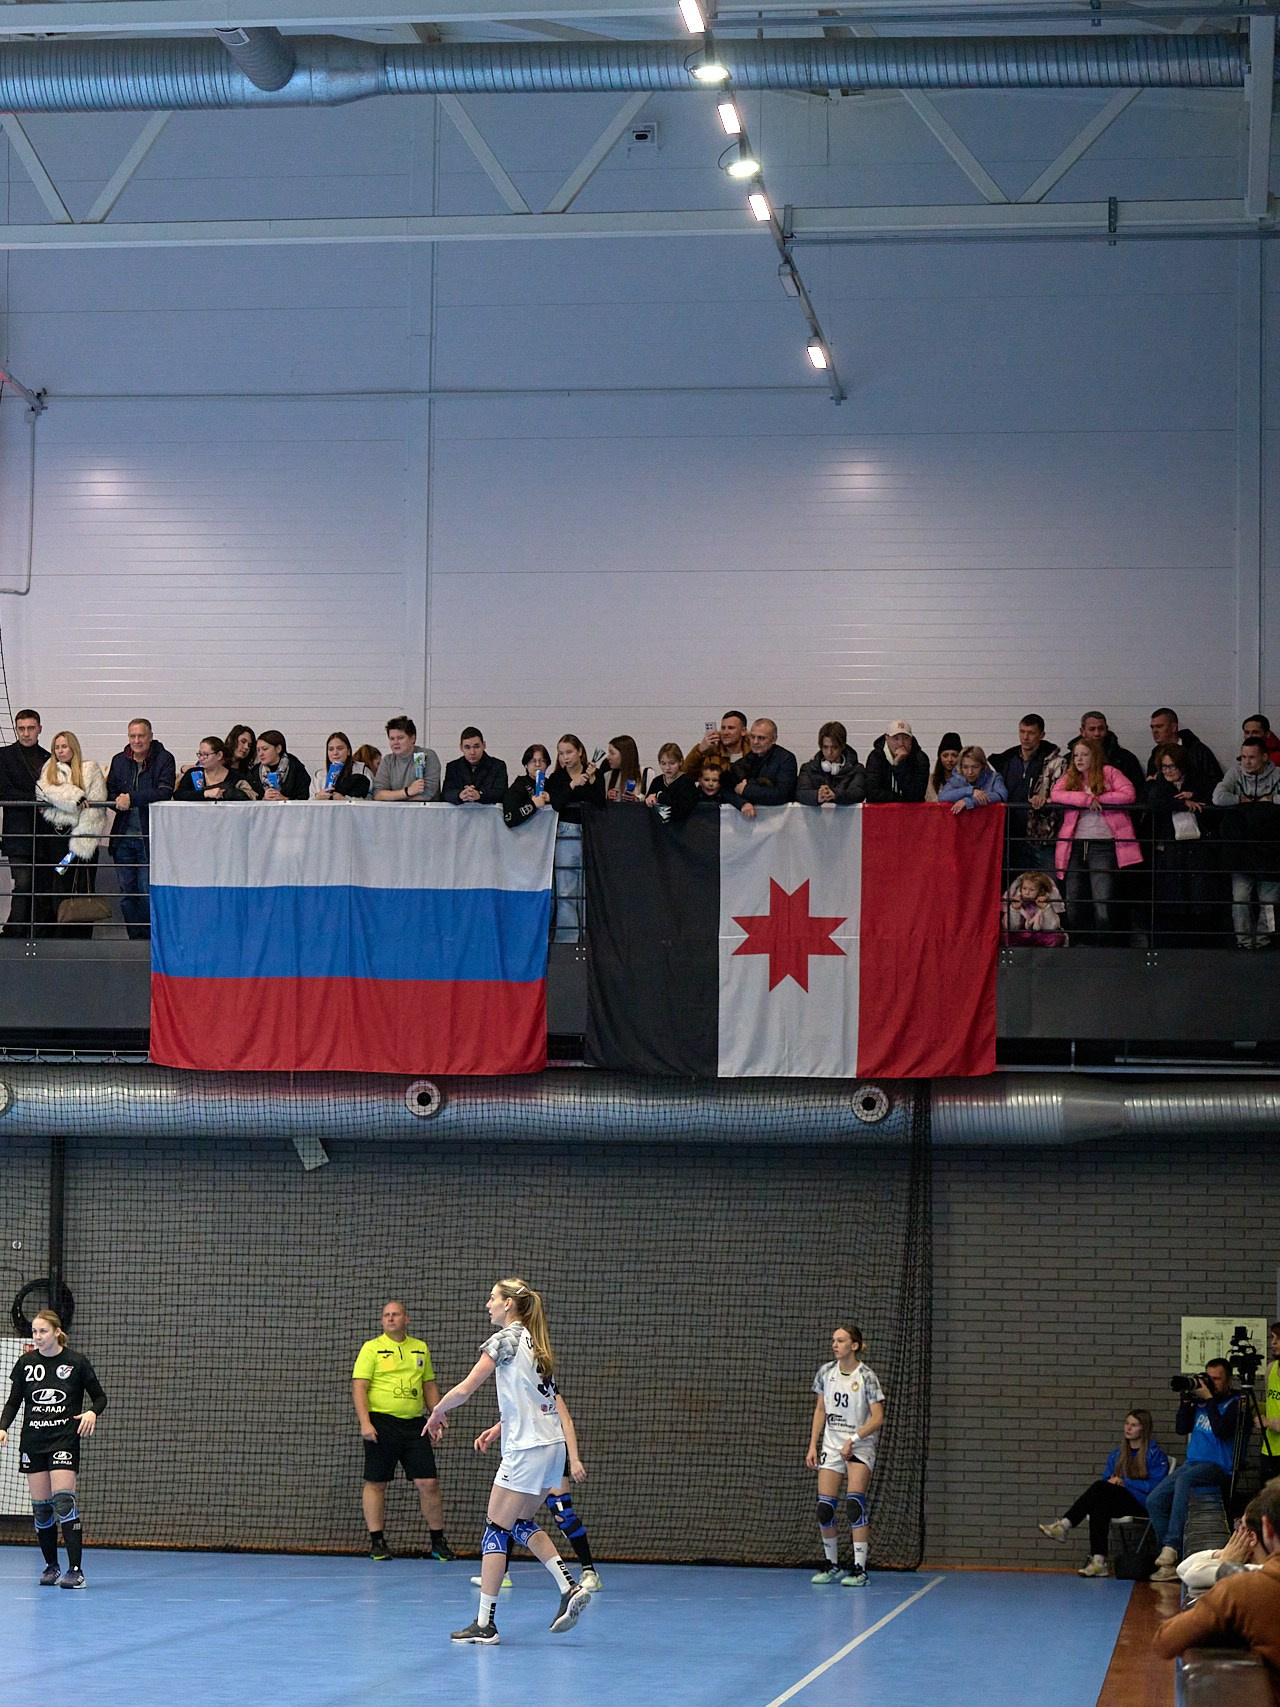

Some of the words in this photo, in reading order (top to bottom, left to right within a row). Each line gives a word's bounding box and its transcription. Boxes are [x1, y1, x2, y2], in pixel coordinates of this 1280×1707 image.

[23, 1364, 46, 1382] 20
[834, 1391, 849, 1408] 93
[29, 1419, 69, 1429] AQUALITY
[820, 1452, 827, 1466] 3
